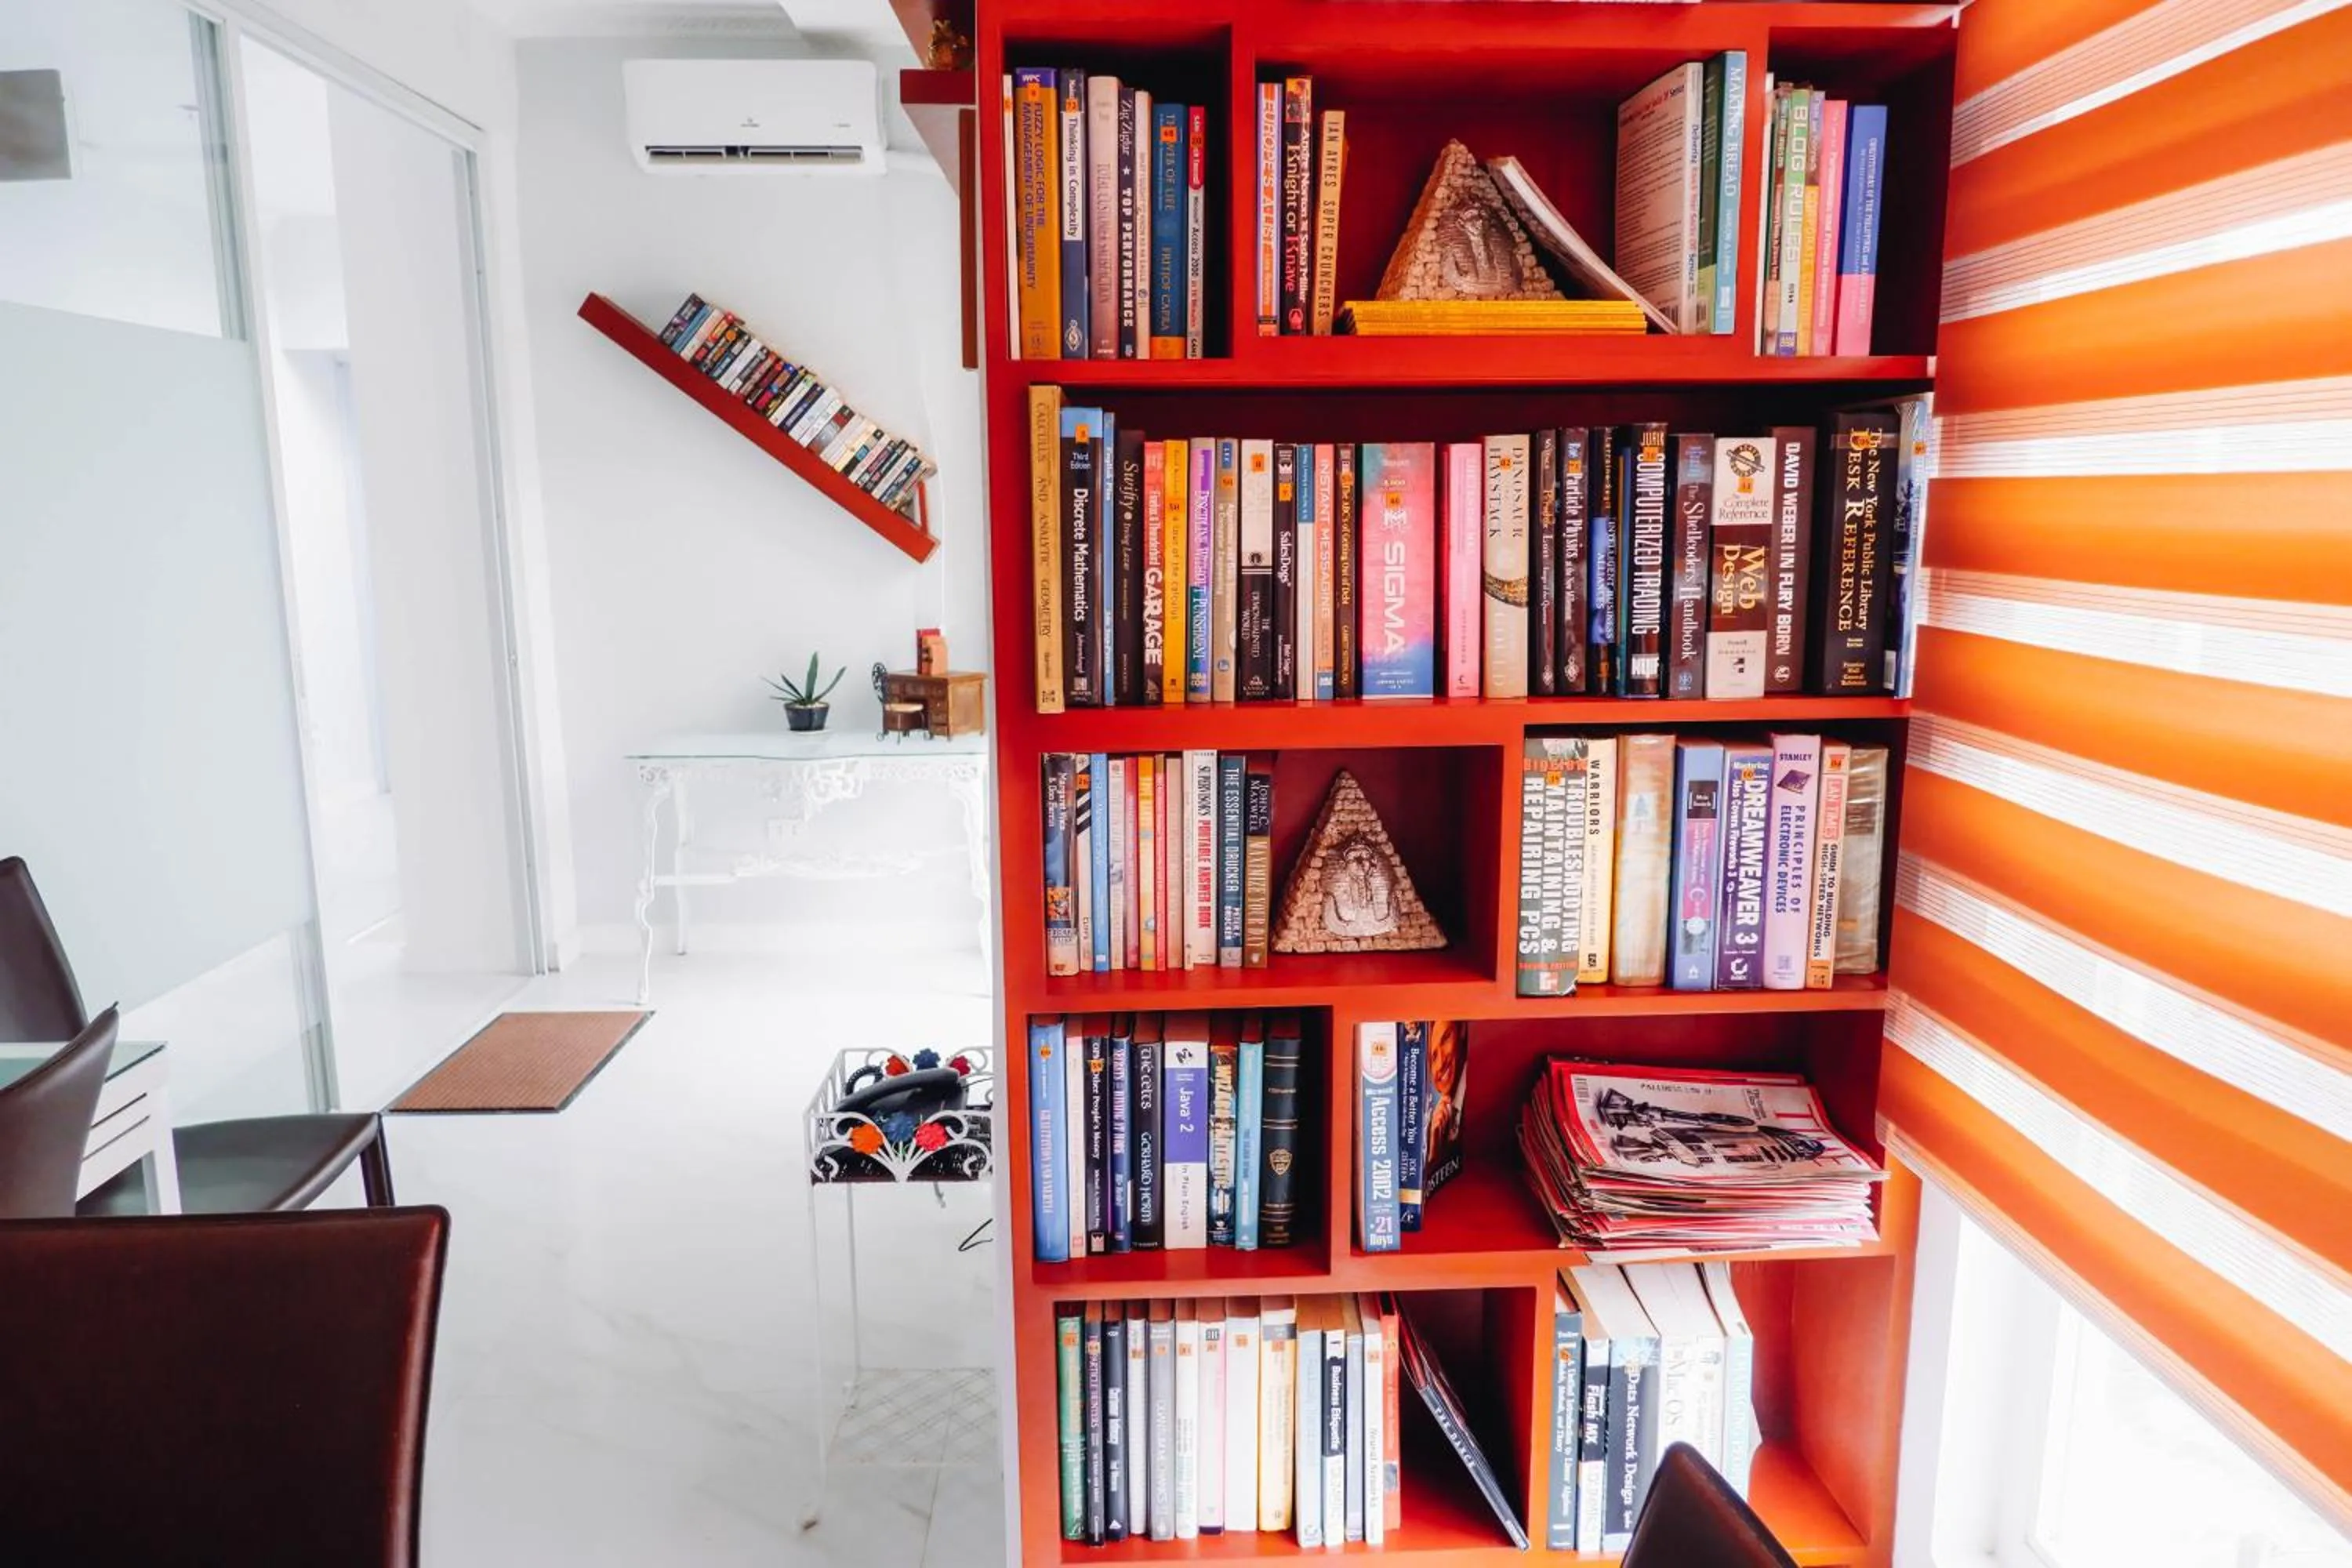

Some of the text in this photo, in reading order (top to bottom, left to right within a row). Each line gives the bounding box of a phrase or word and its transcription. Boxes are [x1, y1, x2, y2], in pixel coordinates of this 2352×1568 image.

[1726, 67, 1742, 137] MAKING
[1034, 103, 1044, 228] FUZZY LOGIC FOR THE
[1066, 117, 1079, 238] Thinking in Complexity
[1724, 143, 1740, 197] BREAD
[1785, 105, 1808, 263] BLOG RULES
[1022, 102, 1035, 289] MANAGEMENT OF UNCERTAINTY
[1119, 100, 1134, 328] Zig Ziglar TOP PERFORMANCE
[1284, 144, 1301, 293] Knight or Knave
[1300, 171, 1310, 218] Norton
[1318, 121, 1340, 318] IAN AYRES SUPER CRUNCHERS
[1298, 234, 1308, 266] Sasha
[1298, 267, 1308, 303] Miller
[1036, 402, 1048, 463] CALCULUS
[1073, 452, 1089, 460] Third
[1036, 475, 1049, 503] AND
[1119, 460, 1140, 510] Swifty
[1341, 485, 1351, 500] The
[1488, 446, 1501, 539] HAYSTACK
[1512, 447, 1524, 539] DINOSAUR
[1566, 472, 1583, 514] Particle
[1690, 485, 1699, 501] The
[1723, 498, 1769, 509] Complete
[1039, 513, 1051, 565] ANALYTIC
[1121, 521, 1132, 546] Irving
[1319, 459, 1330, 619] INSTANT MESSAGING
[1341, 523, 1351, 532] of
[1563, 518, 1583, 559] Physics
[1718, 508, 1769, 521] Reference
[1857, 428, 1883, 630] The New York Public Library
[1073, 488, 1090, 622] Discrete Mathematics
[1122, 547, 1132, 571] Lazar
[1341, 532, 1351, 561] Getting
[1542, 534, 1553, 558] Lost
[1632, 452, 1665, 635] COMPUTERIZED TRADING
[1775, 441, 1801, 655] DAVID WEBER IN FURY BORN
[1838, 499, 1866, 633] REFERENCE
[1171, 562, 1179, 577] the
[1192, 490, 1209, 659] DISCIPLINE WITHOUT PUNISHMENT
[1341, 561, 1351, 577] Out
[1341, 577, 1351, 586] of
[1596, 552, 1605, 609] ALLIANCES
[1605, 521, 1616, 640] INTELLIGENT BUSINESS
[1716, 543, 1742, 615] Design
[1738, 546, 1766, 609] Web
[1039, 579, 1052, 638] GEOMETRY
[1144, 567, 1163, 666] GARAGE
[1171, 581, 1179, 621] calculus
[1341, 587, 1351, 605] Debt
[1383, 540, 1406, 655] SIGMA
[1242, 608, 1250, 640] WORLD
[1679, 586, 1704, 660] Handbook
[1779, 753, 1813, 761] STANLEY
[1248, 779, 1259, 833] MAXWELL
[1258, 784, 1270, 828] JOHN C.
[1588, 759, 1600, 836] WARRIORS
[1730, 799, 1741, 828] Covers
[1824, 781, 1841, 839] LAN TIMES
[1198, 818, 1212, 863] PORTABLE
[1225, 767, 1240, 892] THE ESSENTIAL DRUCKER
[1728, 829, 1740, 869] Fireworks
[1518, 775, 1544, 955] REPAIRING PCS
[1541, 778, 1566, 953] MAINTAINING &
[1560, 775, 1587, 953] TROUBLESHOOTING
[1735, 780, 1767, 945] DREAMWEAVER 3
[1775, 804, 1792, 914] ELECTRONIC DEVICES
[1790, 804, 1806, 913] PRINCIPLES OF
[1198, 866, 1212, 902] ANSWER
[1247, 840, 1268, 948] MAXIMIZE YOUR DAY
[1813, 843, 1829, 958] HIGH-SPEED NETWORKS
[1824, 843, 1838, 938] GUIDE TO BUILDING
[1198, 905, 1212, 929] BOOK
[1224, 905, 1232, 941] DRUCKER
[1409, 1047, 1420, 1086] Become
[1179, 1087, 1194, 1133] Java 2
[1408, 1094, 1419, 1125] Better
[1091, 1131, 1101, 1160] Money
[1407, 1127, 1418, 1144] You
[1372, 1159, 1392, 1200] 2002
[1400, 1151, 1410, 1182] OSTEEN
[1408, 1157, 1417, 1177] JOEL
[1181, 1200, 1189, 1230] English
[1375, 1216, 1392, 1233] 21
[1330, 1365, 1342, 1406] Business
[1330, 1407, 1342, 1450] Etiquette
[1563, 1398, 1575, 1446] Introduction
[1584, 1385, 1601, 1444] Flash MX
[1623, 1373, 1639, 1504] Data Network Design
[1563, 1457, 1573, 1483] Linear
